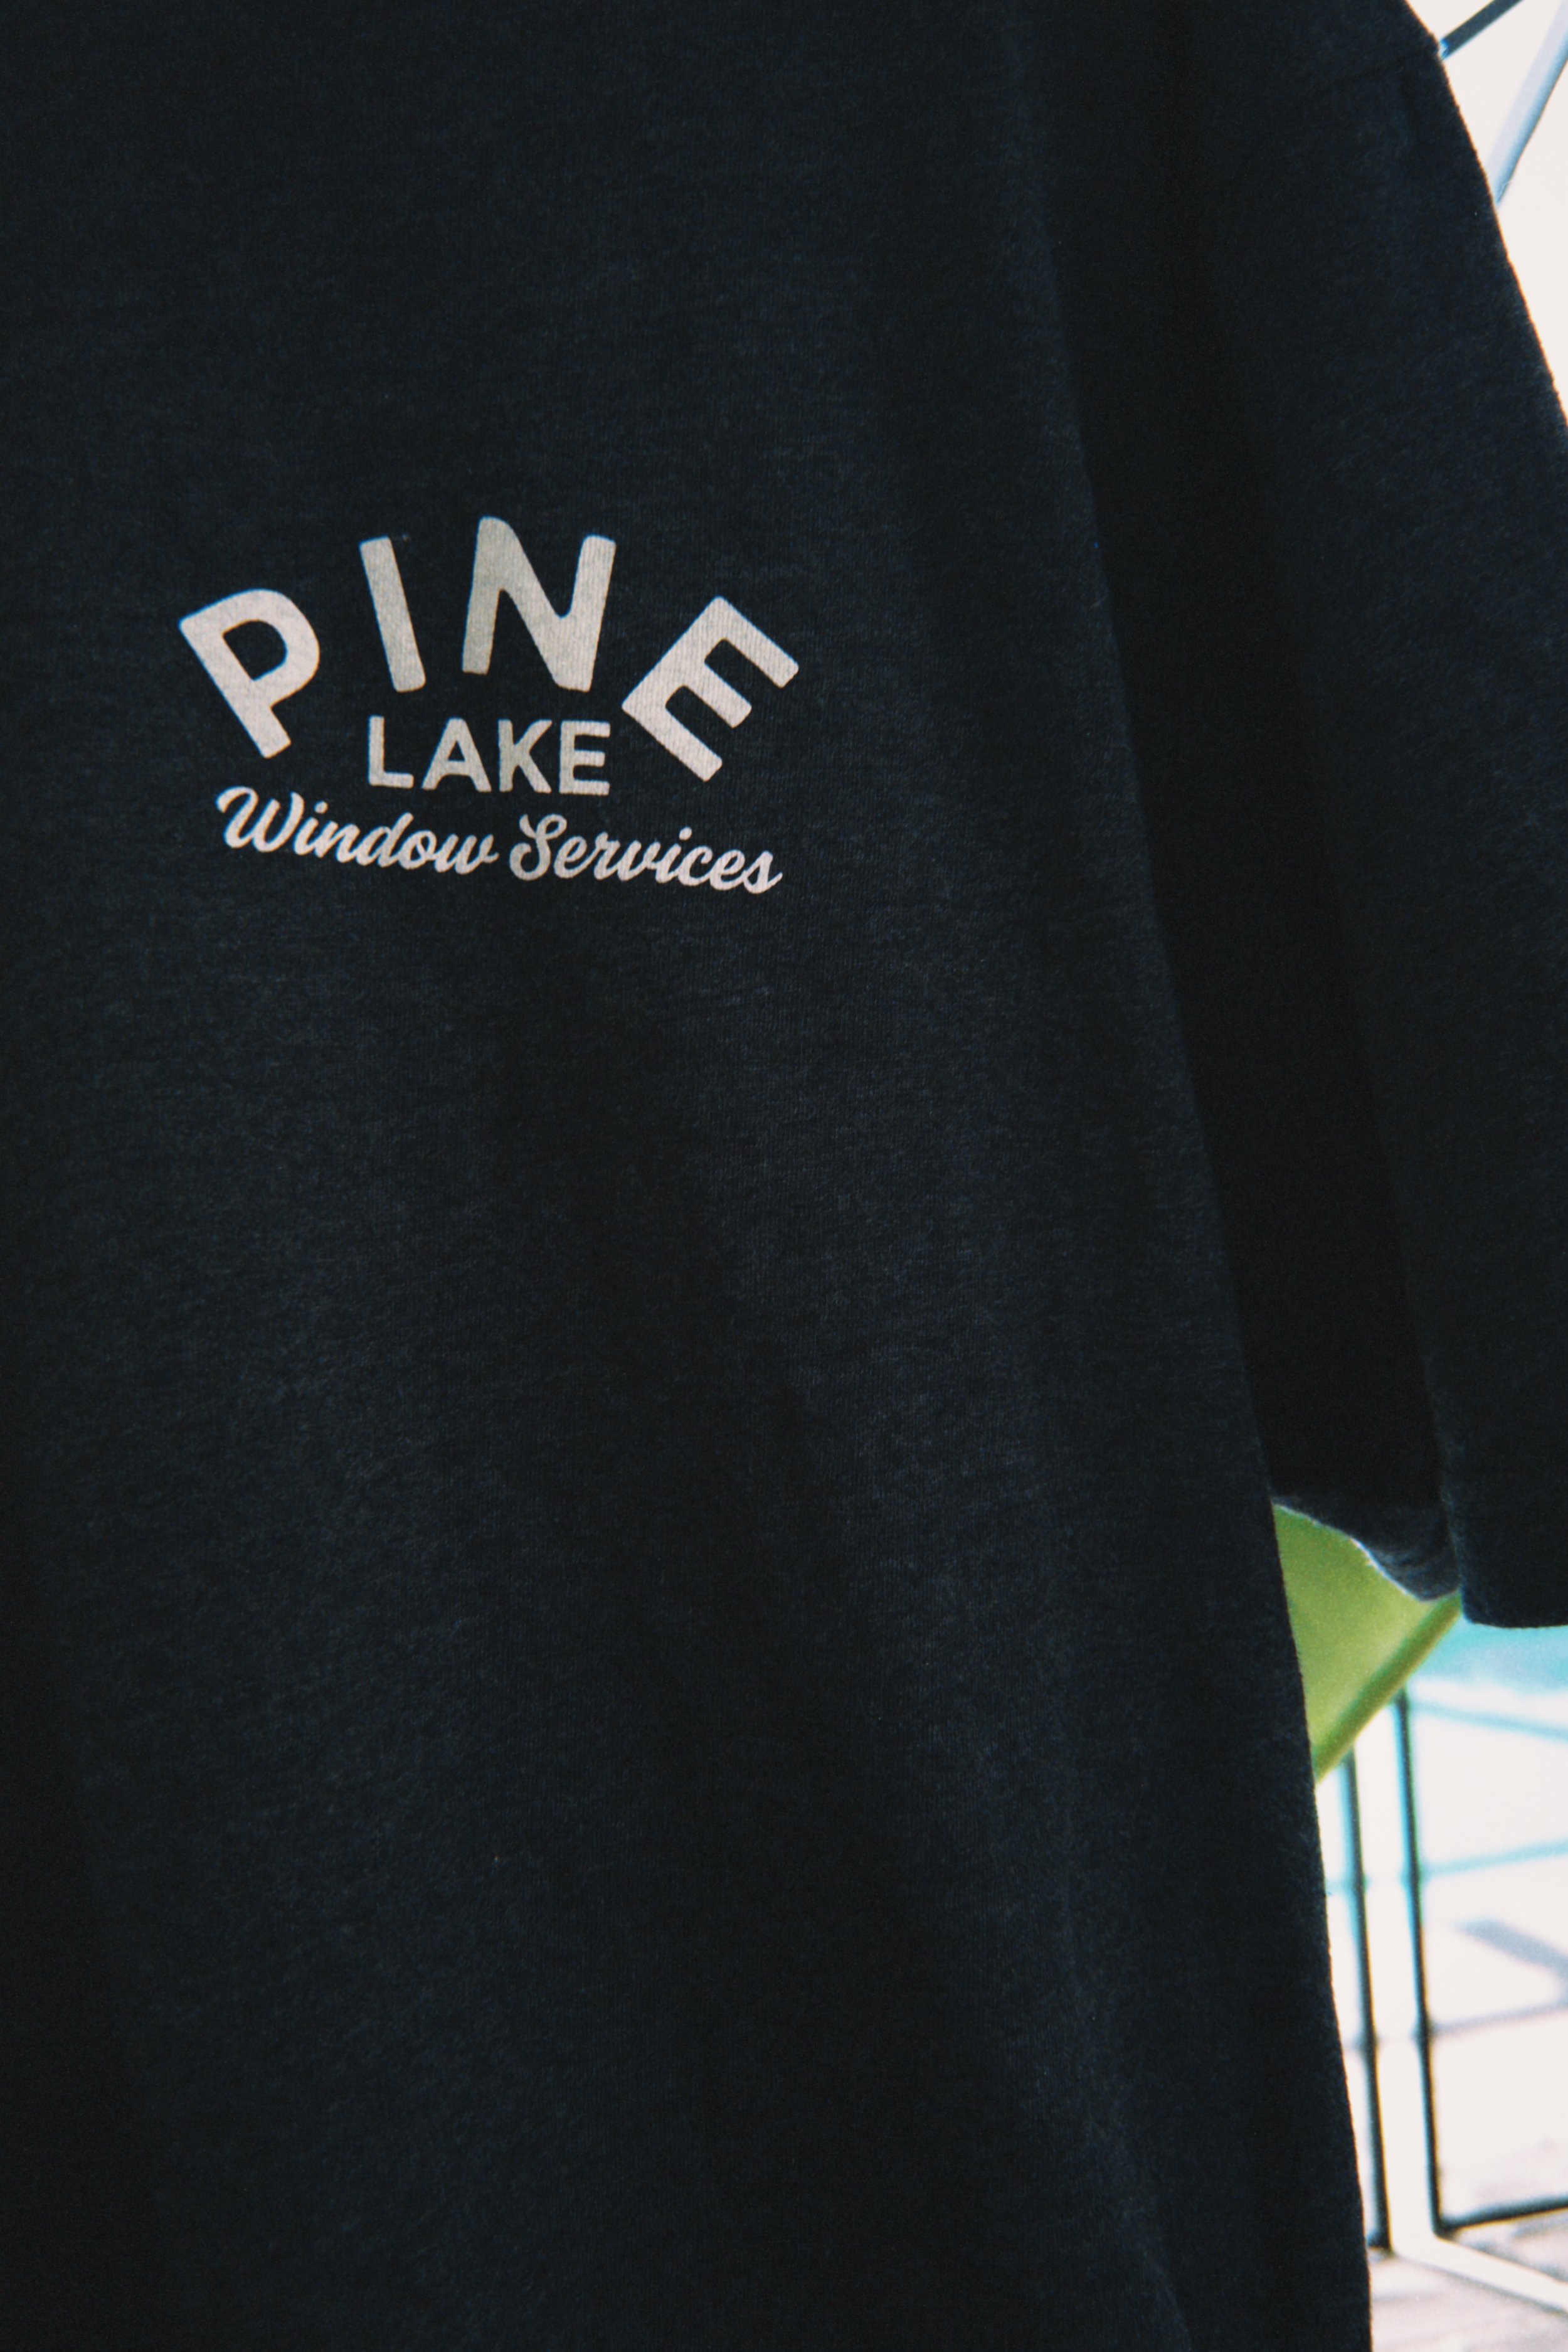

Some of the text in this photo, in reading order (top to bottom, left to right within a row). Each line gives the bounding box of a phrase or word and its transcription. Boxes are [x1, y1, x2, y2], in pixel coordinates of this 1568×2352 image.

[179, 516, 799, 782] PINE
[368, 715, 611, 796] LAKE
[216, 786, 783, 895] Window Services
